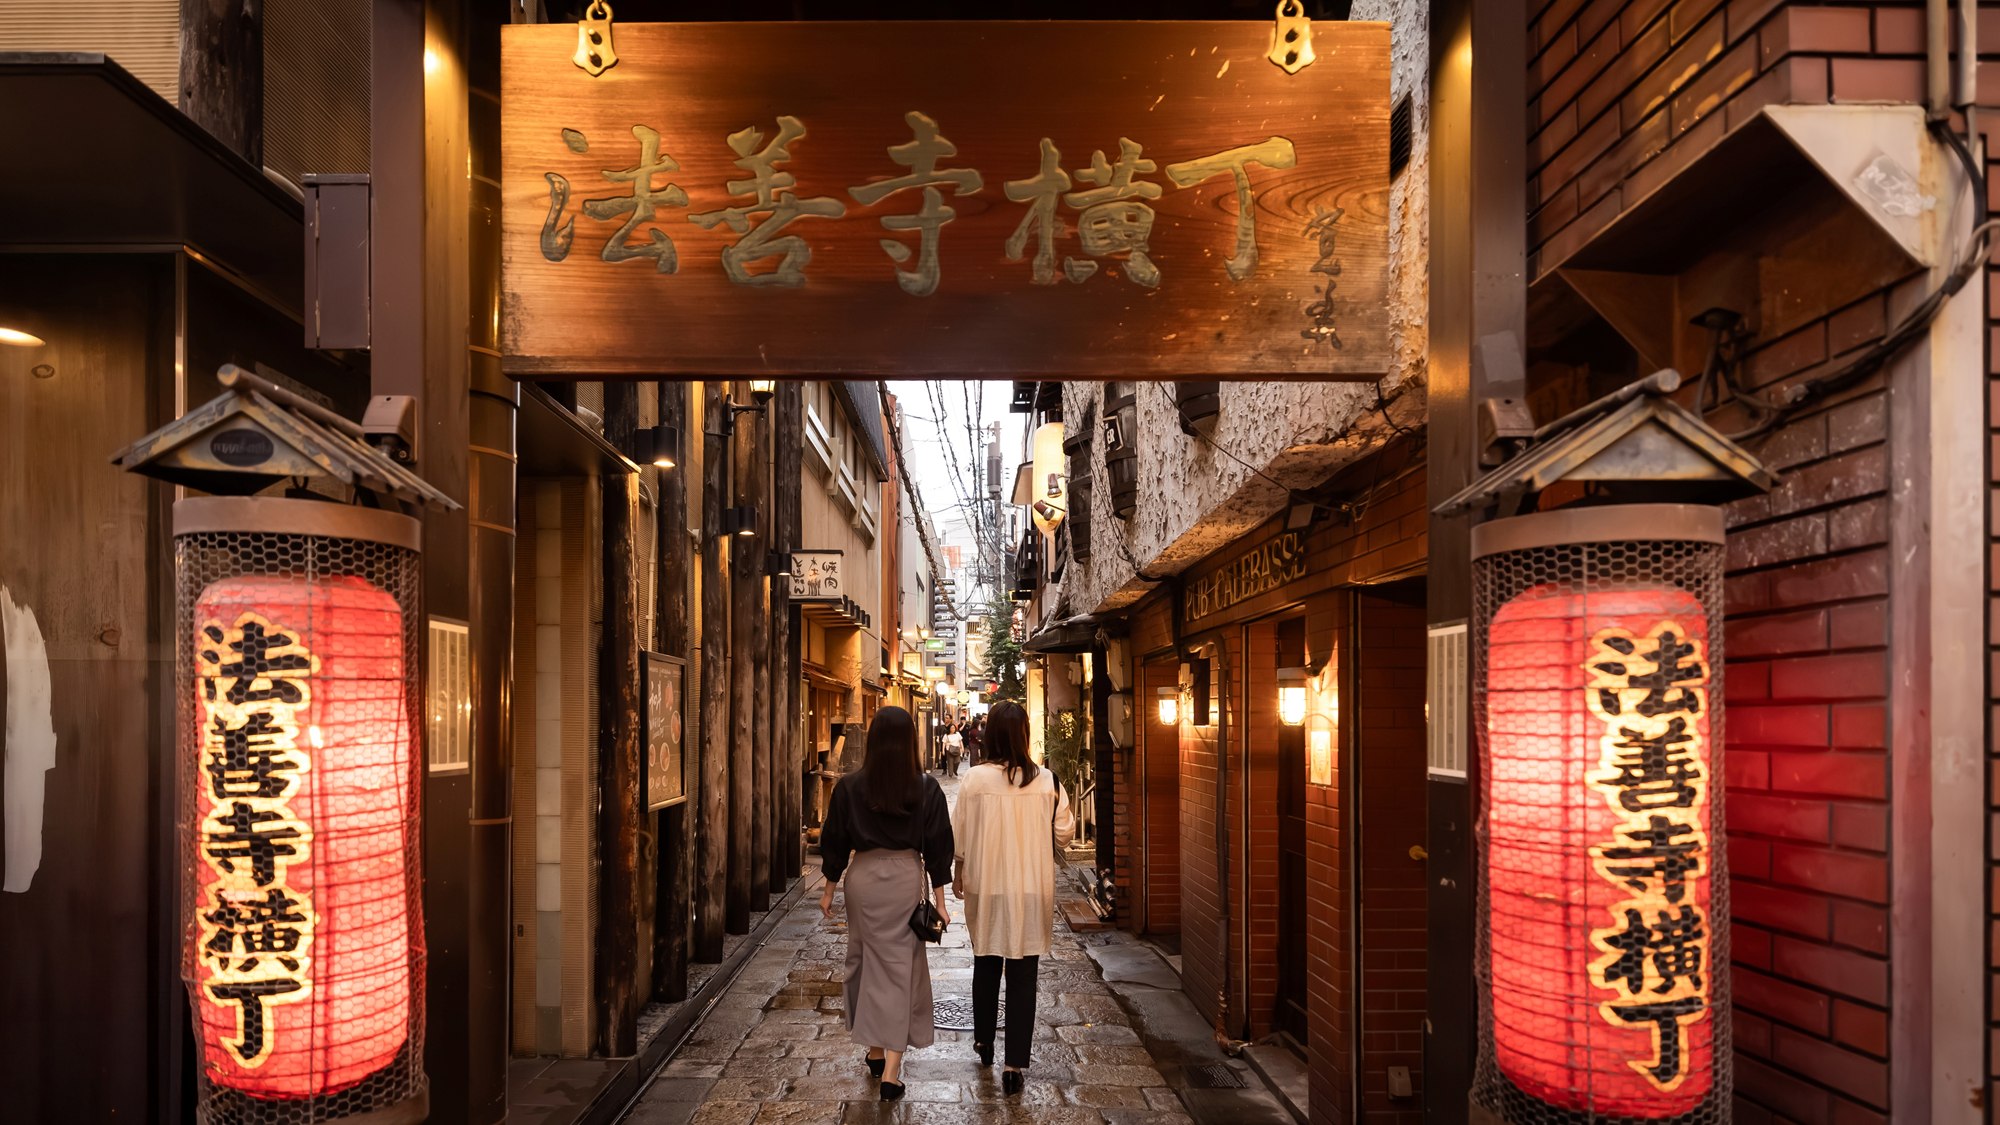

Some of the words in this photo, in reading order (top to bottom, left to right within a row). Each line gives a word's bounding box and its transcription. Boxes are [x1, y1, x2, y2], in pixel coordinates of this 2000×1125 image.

[539, 111, 1298, 296] 法善寺横丁
[1186, 578, 1209, 622] PUB
[1214, 532, 1306, 610] CALEBASSE
[198, 615, 316, 1064] 法善寺横丁
[1591, 625, 1708, 1087] 法善寺横丁
